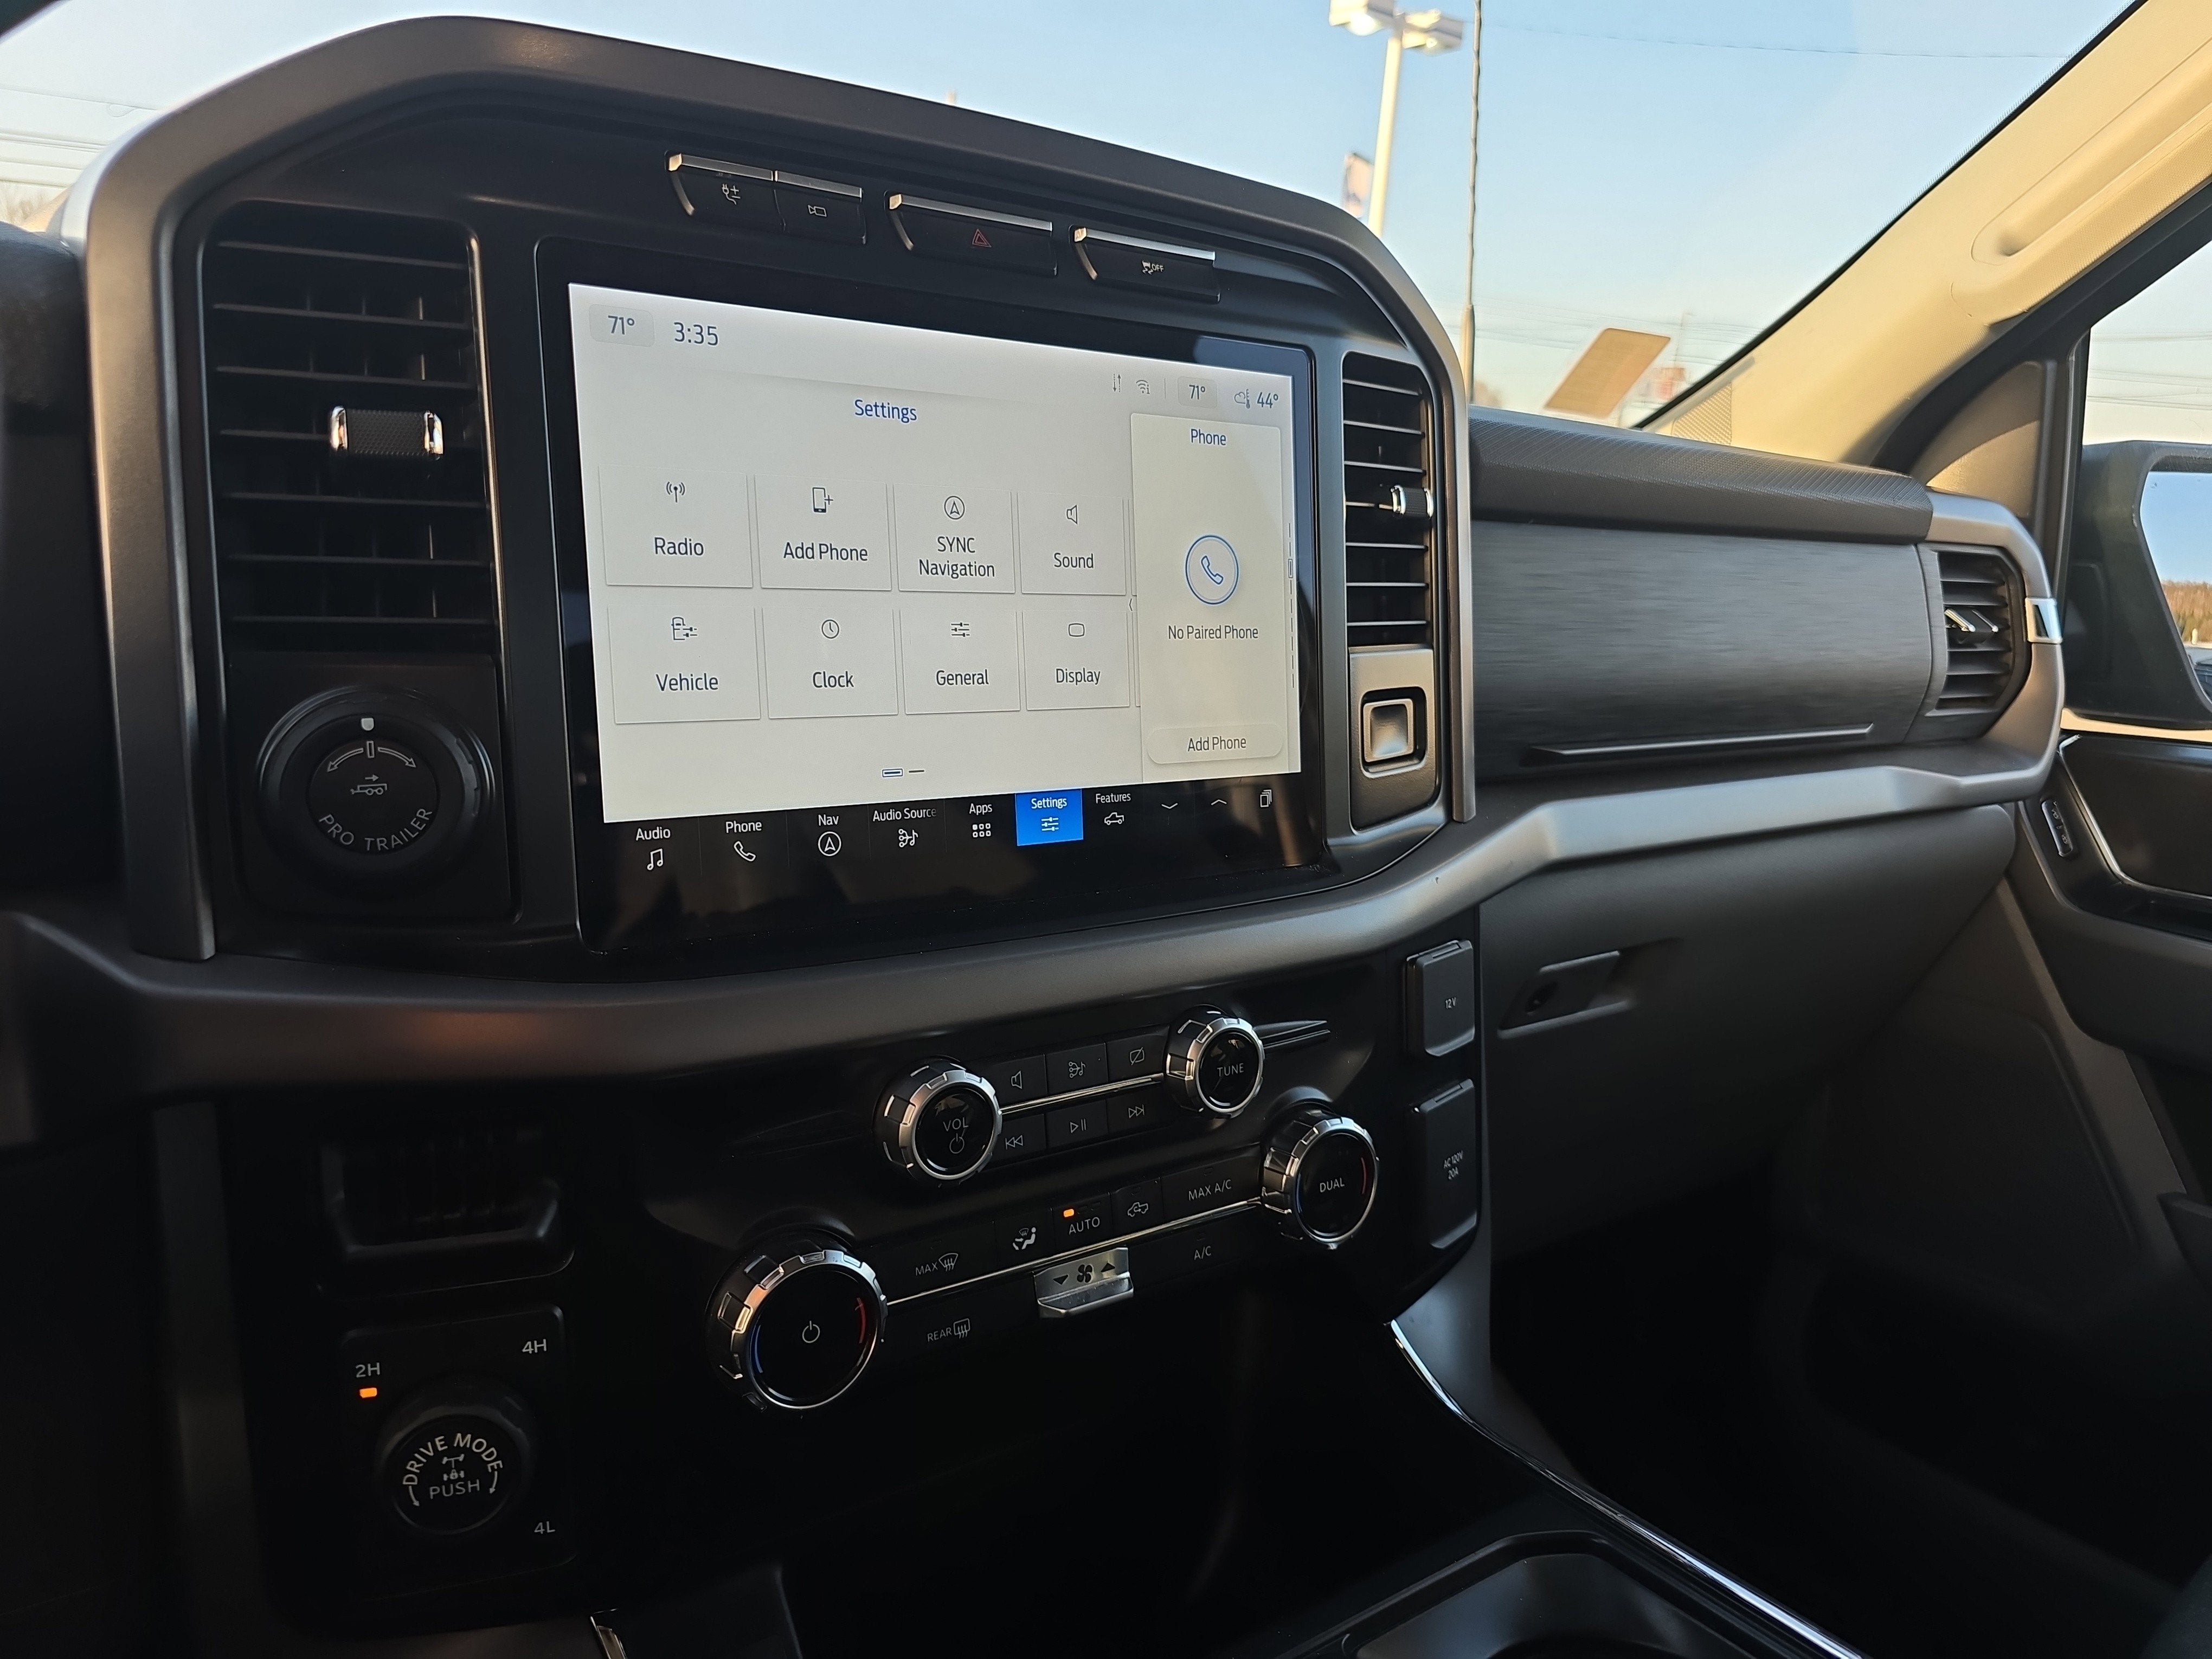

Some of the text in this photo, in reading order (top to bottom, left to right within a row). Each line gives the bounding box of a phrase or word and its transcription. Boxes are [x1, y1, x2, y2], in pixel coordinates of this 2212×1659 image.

[1152, 263, 1164, 272] OFF
[673, 321, 719, 346] 3:35
[854, 399, 917, 423] Settings
[1190, 428, 1226, 446] Phone
[654, 537, 704, 557] Radio
[783, 542, 869, 562] Add Phone
[937, 536, 976, 554] SYNC
[1053, 552, 1094, 569] Sound
[919, 559, 995, 579] Navigation
[1168, 625, 1258, 640] No Paired Phone
[655, 672, 719, 692] Vehicle
[812, 671, 854, 689] Clock
[936, 669, 989, 686] General
[1056, 667, 1101, 686] Display
[1187, 735, 1246, 752] Add Phone
[1031, 796, 1067, 811] Settings
[1095, 791, 1131, 804] Features
[872, 806, 937, 821] Audio Source
[969, 802, 993, 815] Apps
[725, 819, 762, 834] Phone
[818, 814, 839, 827] Nav
[319, 808, 432, 852] PRO TRAILER
[635, 827, 671, 840] Audio
[1445, 996, 1456, 1009] 12V
[1217, 1063, 1244, 1076] TUNE
[943, 1117, 969, 1131] VOL
[1443, 1150, 1463, 1169] AC 120V
[1448, 1167, 1459, 1180] 20A
[1188, 1179, 1232, 1201] MAX A/C
[1319, 1178, 1345, 1193] DUAL
[1069, 1217, 1101, 1234] AUTO
[1193, 1245, 1212, 1261] A/C
[915, 1262, 938, 1276] MAX
[927, 1326, 952, 1342] REAR
[522, 1339, 547, 1354] 4H
[356, 1362, 380, 1378] 2H
[402, 1433, 503, 1486] DRIVE MODE
[430, 1479, 480, 1499] PUSH
[534, 1521, 555, 1534] 4L
